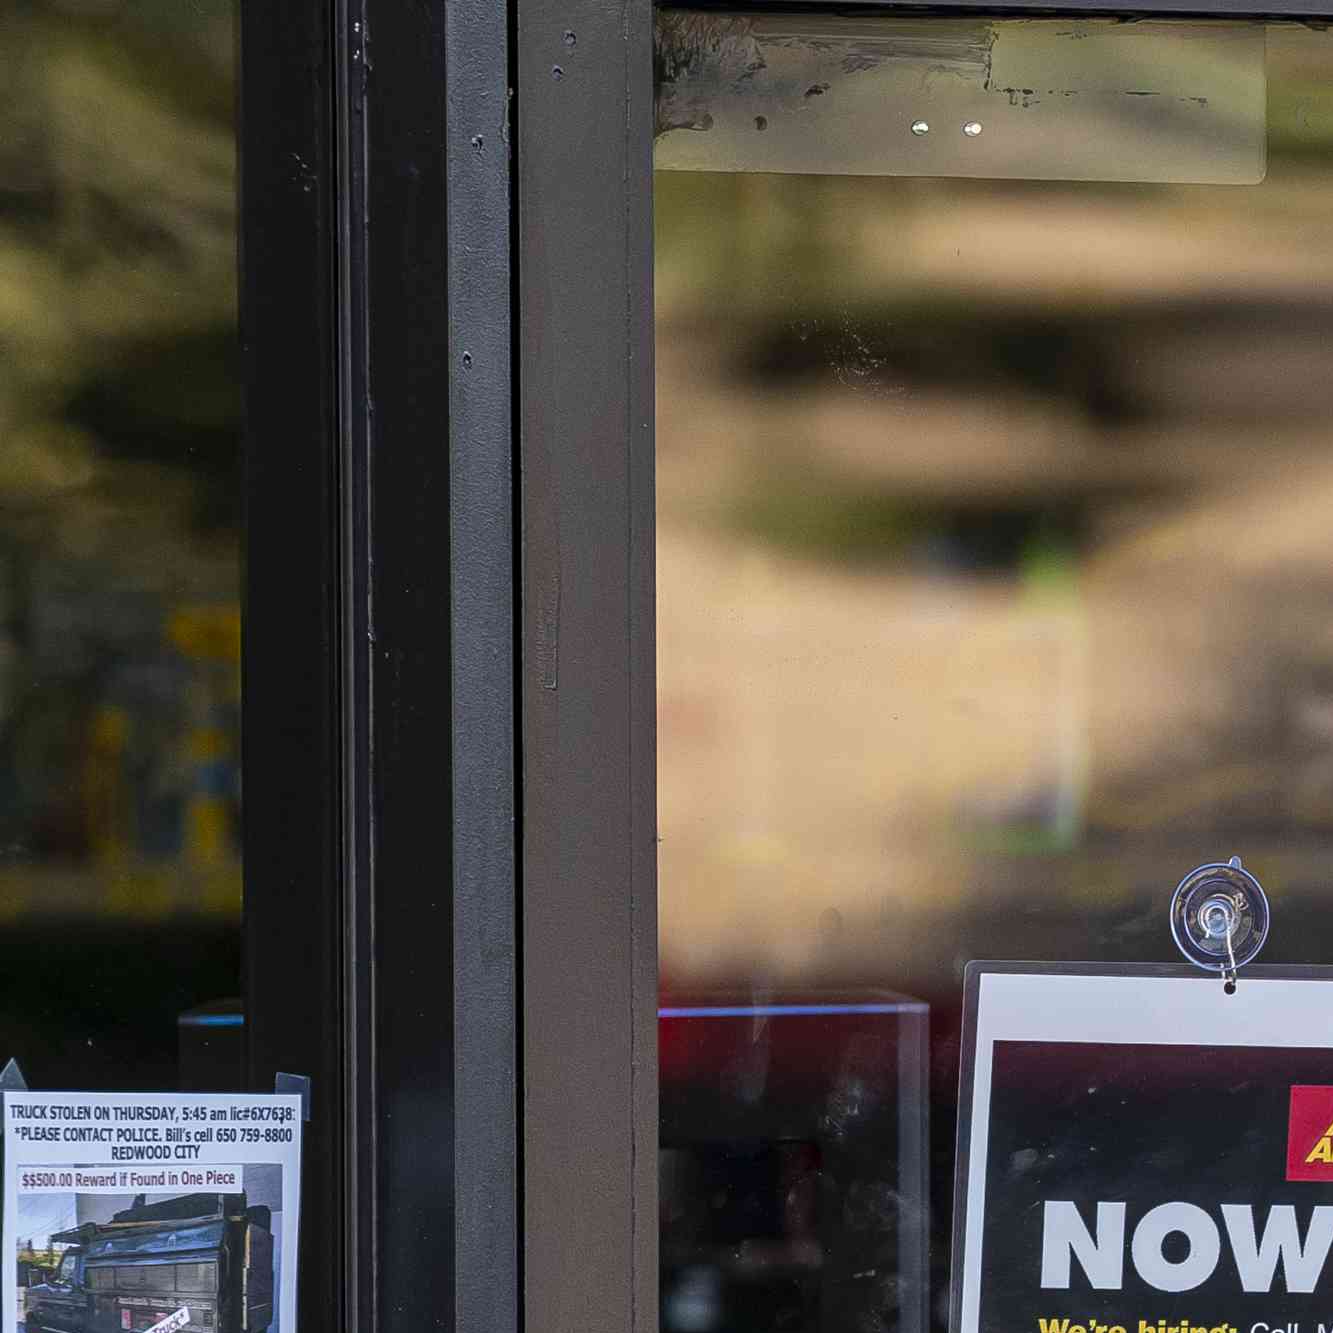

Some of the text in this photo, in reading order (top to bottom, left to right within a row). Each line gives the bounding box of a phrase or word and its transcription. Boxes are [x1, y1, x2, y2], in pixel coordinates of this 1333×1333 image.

[10, 1104, 48, 1120] TRUCK
[50, 1105, 91, 1120] STOLEN
[94, 1105, 109, 1120] ON
[113, 1106, 179, 1123] THURSDAY,
[182, 1106, 207, 1121] 5:45
[210, 1109, 227, 1121] am
[63, 1127, 113, 1142] CONTACT
[117, 1128, 162, 1142] POLICE.
[166, 1127, 191, 1142] Bill's
[194, 1128, 212, 1142] cell
[216, 1128, 236, 1142] 650
[240, 1128, 292, 1142] 759-8800
[112, 1144, 200, 1160] REDWOOD CITY
[76, 1173, 116, 1187] Reward
[120, 1172, 127, 1186] if
[131, 1171, 165, 1186] Found
[168, 1171, 178, 1185] in
[182, 1171, 202, 1185] One
[206, 1170, 235, 1185] Piece
